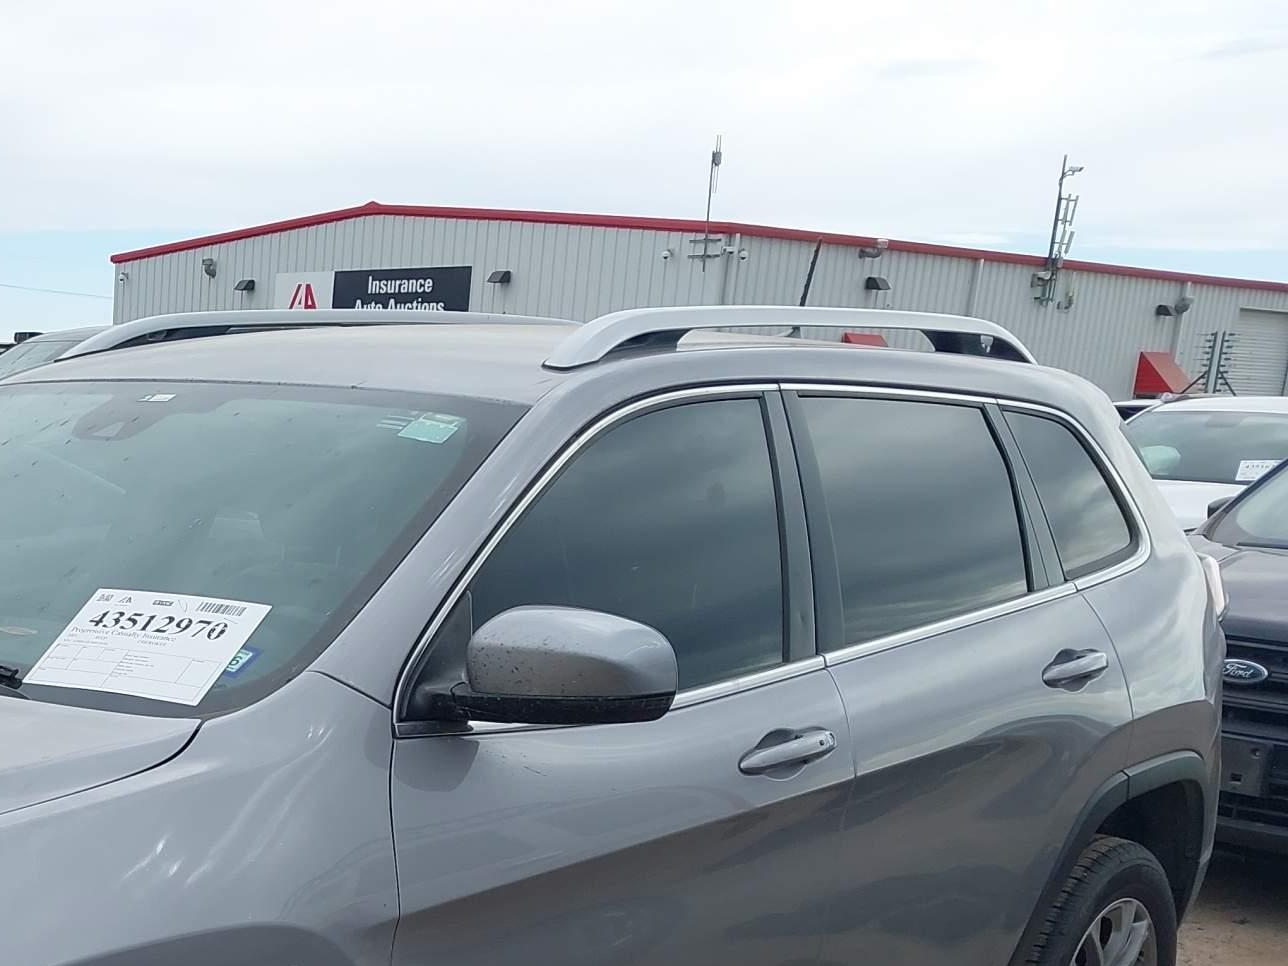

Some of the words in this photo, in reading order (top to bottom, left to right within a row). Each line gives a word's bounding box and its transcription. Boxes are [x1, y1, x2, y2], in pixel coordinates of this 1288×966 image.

[367, 275, 434, 294] Insurance
[88, 610, 229, 641] 43512970
[1223, 663, 1254, 678] Ford
